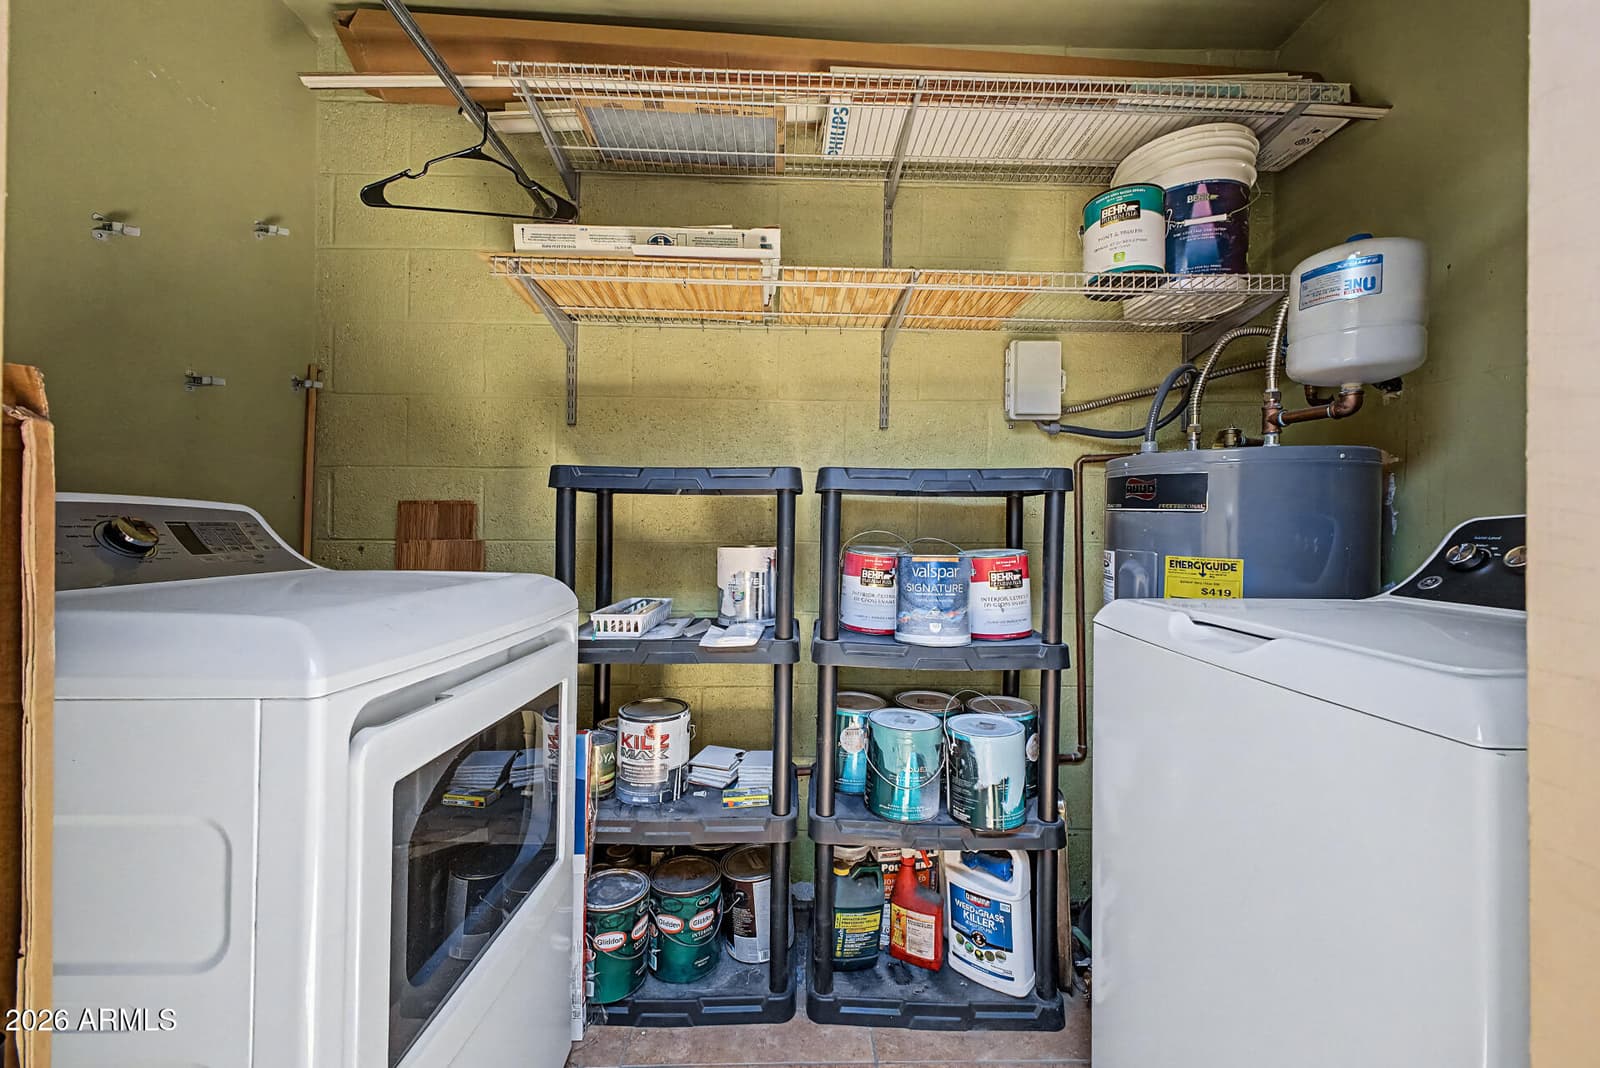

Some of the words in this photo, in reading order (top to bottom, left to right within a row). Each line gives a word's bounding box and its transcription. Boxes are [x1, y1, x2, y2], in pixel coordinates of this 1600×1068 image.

[1101, 203, 1127, 218] BEHR
[911, 563, 960, 581] valspar
[1169, 559, 1237, 573] ENERGYGUIDE
[862, 570, 884, 579] BEHR
[991, 572, 1013, 582] BEHR
[906, 583, 963, 593] SIGNATURE
[621, 731, 670, 750] KILZ
[621, 746, 669, 760] MAX
[954, 898, 975, 914] WEED
[978, 909, 1005, 923] GRASS
[658, 918, 680, 928] Glidden
[963, 910, 995, 931] KILLER
